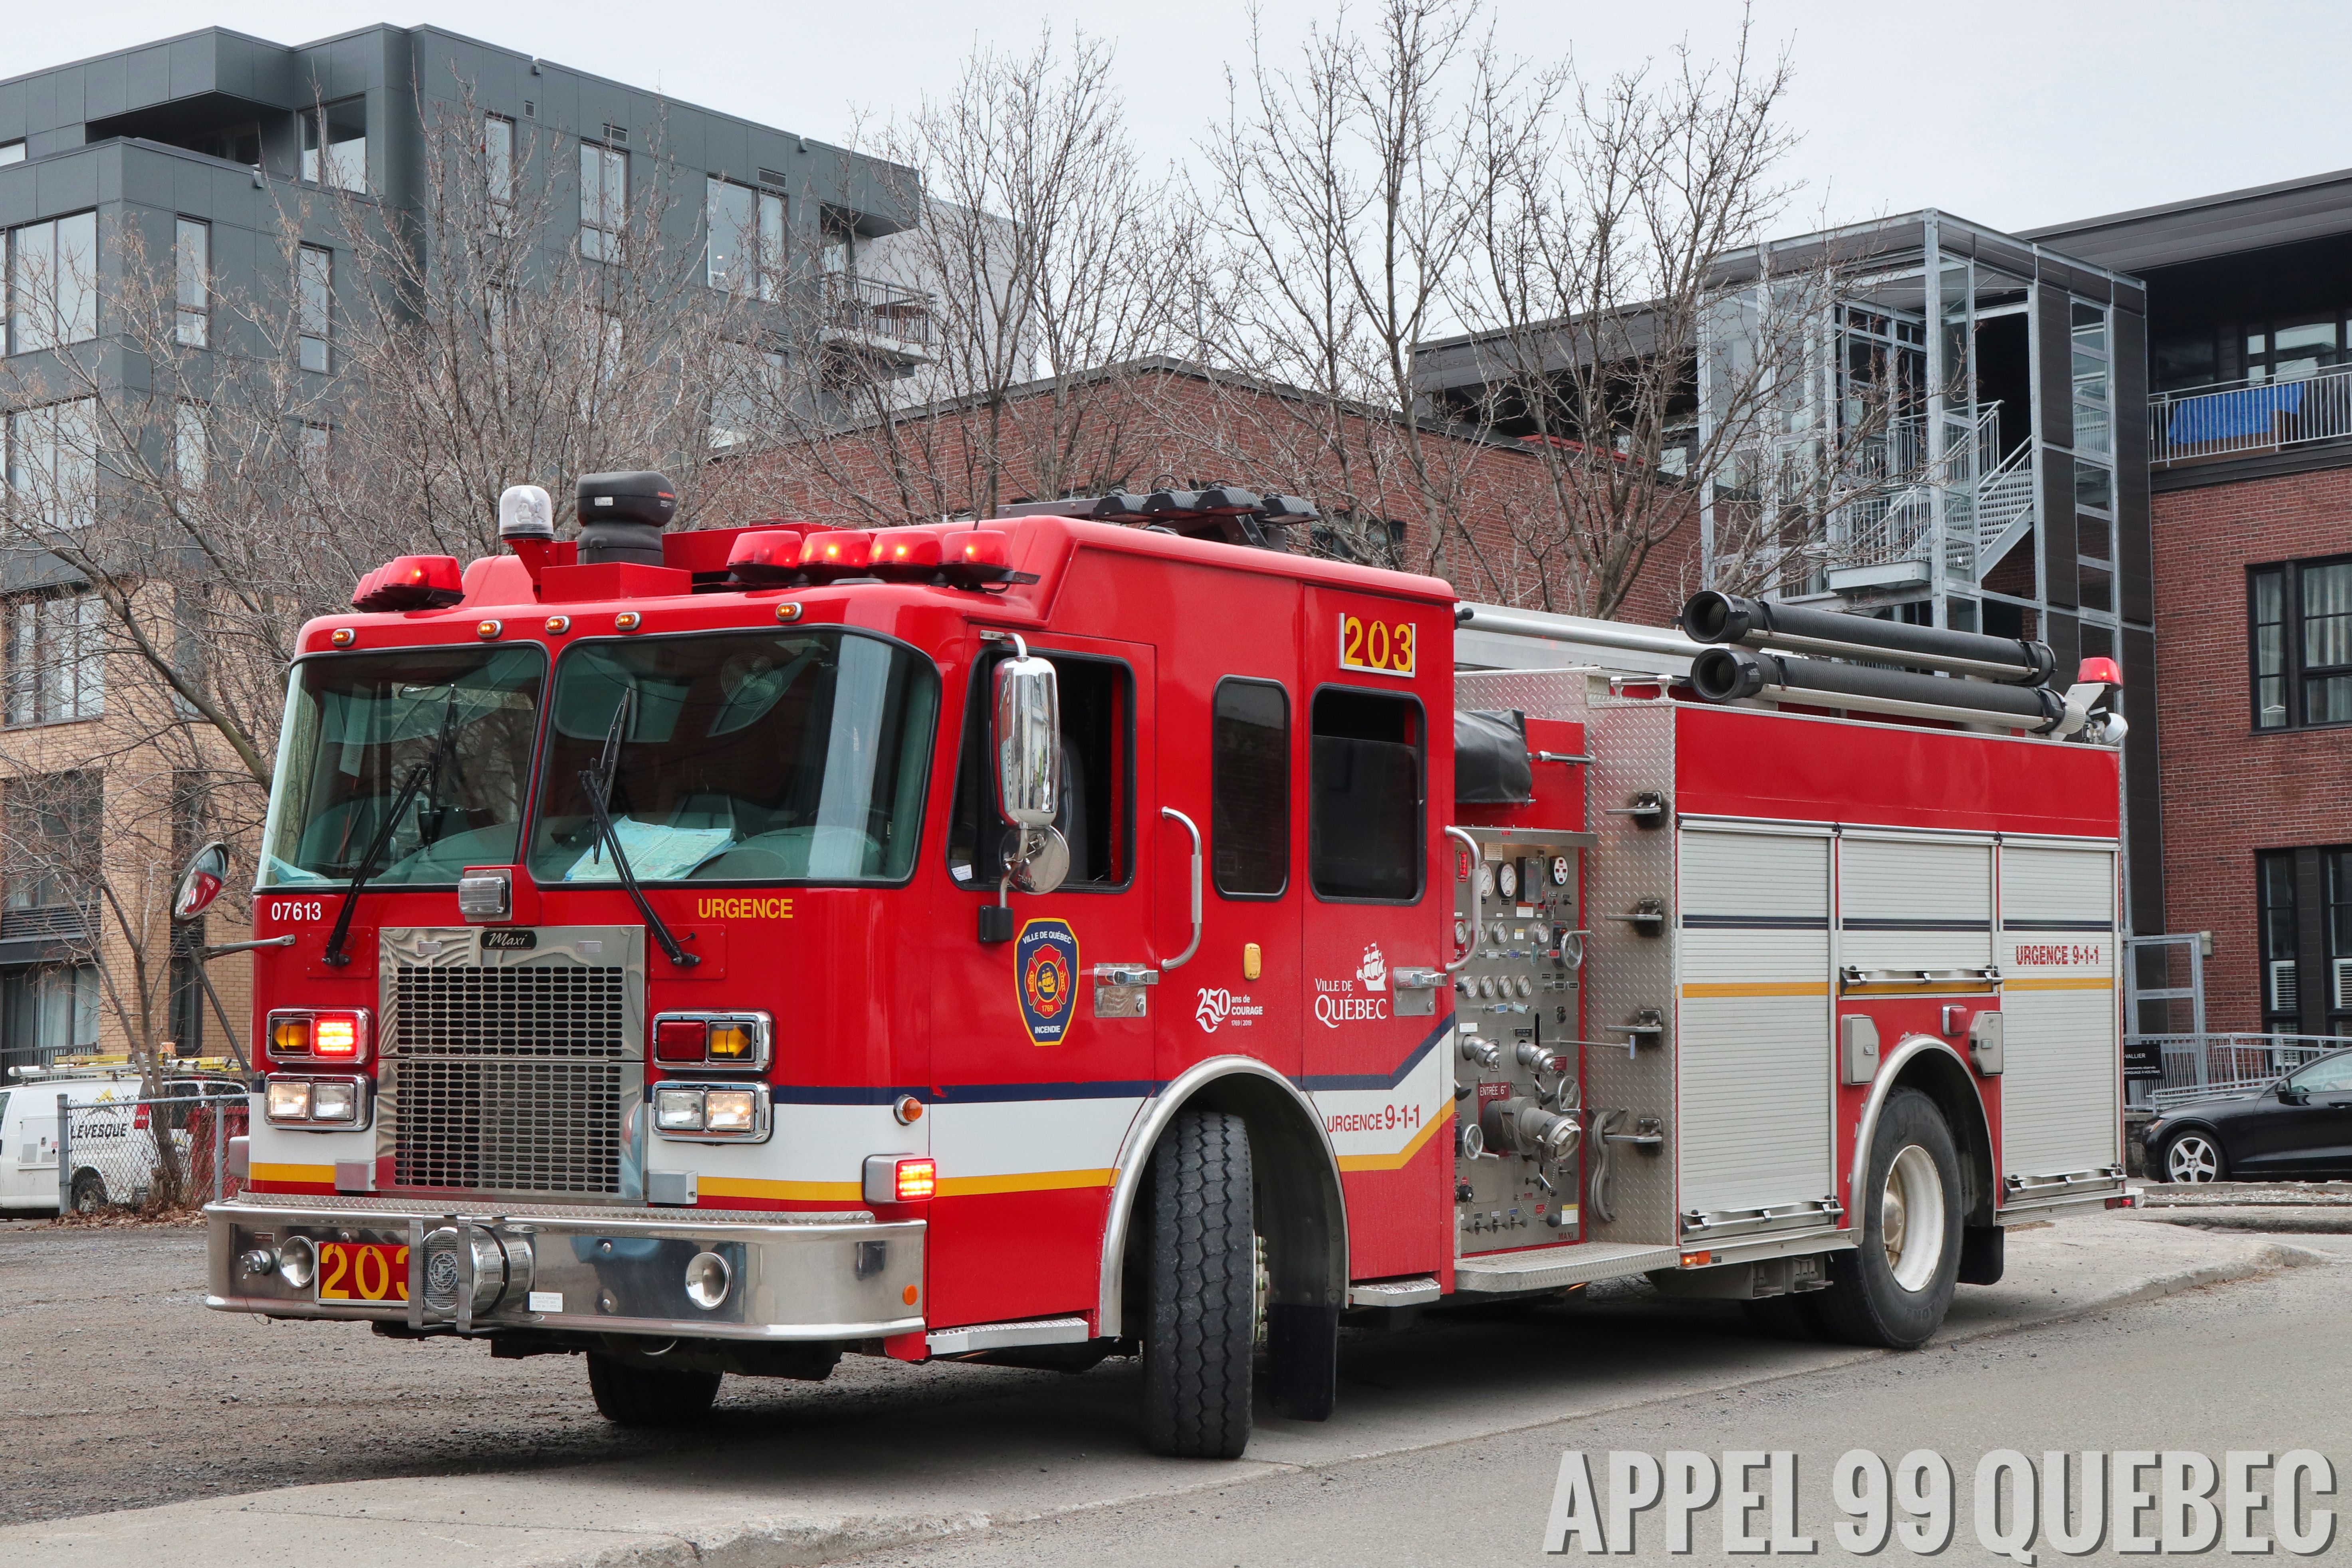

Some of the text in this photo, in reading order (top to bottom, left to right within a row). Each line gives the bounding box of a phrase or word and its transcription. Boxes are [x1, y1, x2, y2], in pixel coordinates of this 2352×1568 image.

[1344, 616, 1413, 672] 203
[271, 902, 321, 921] 07613
[698, 898, 793, 918] URGENCE
[488, 932, 528, 946] Maxi
[1022, 930, 1072, 944] VILLE DE QUÉBEC
[2016, 945, 2098, 965] URGENCE 9-1-1
[1195, 987, 1231, 1022] 250
[1243, 994, 1251, 1003] de
[1231, 1006, 1263, 1015] COURAGE
[1315, 994, 1387, 1029] QUÉBEC
[1035, 1025, 1061, 1034] INCENDIE
[1479, 1084, 1499, 1096] ENTRÉE
[1327, 1104, 1420, 1133] URGENCE 9-1-1
[71, 1121, 127, 1139] LÉVESQUE
[1558, 1231, 1574, 1241] MAXI
